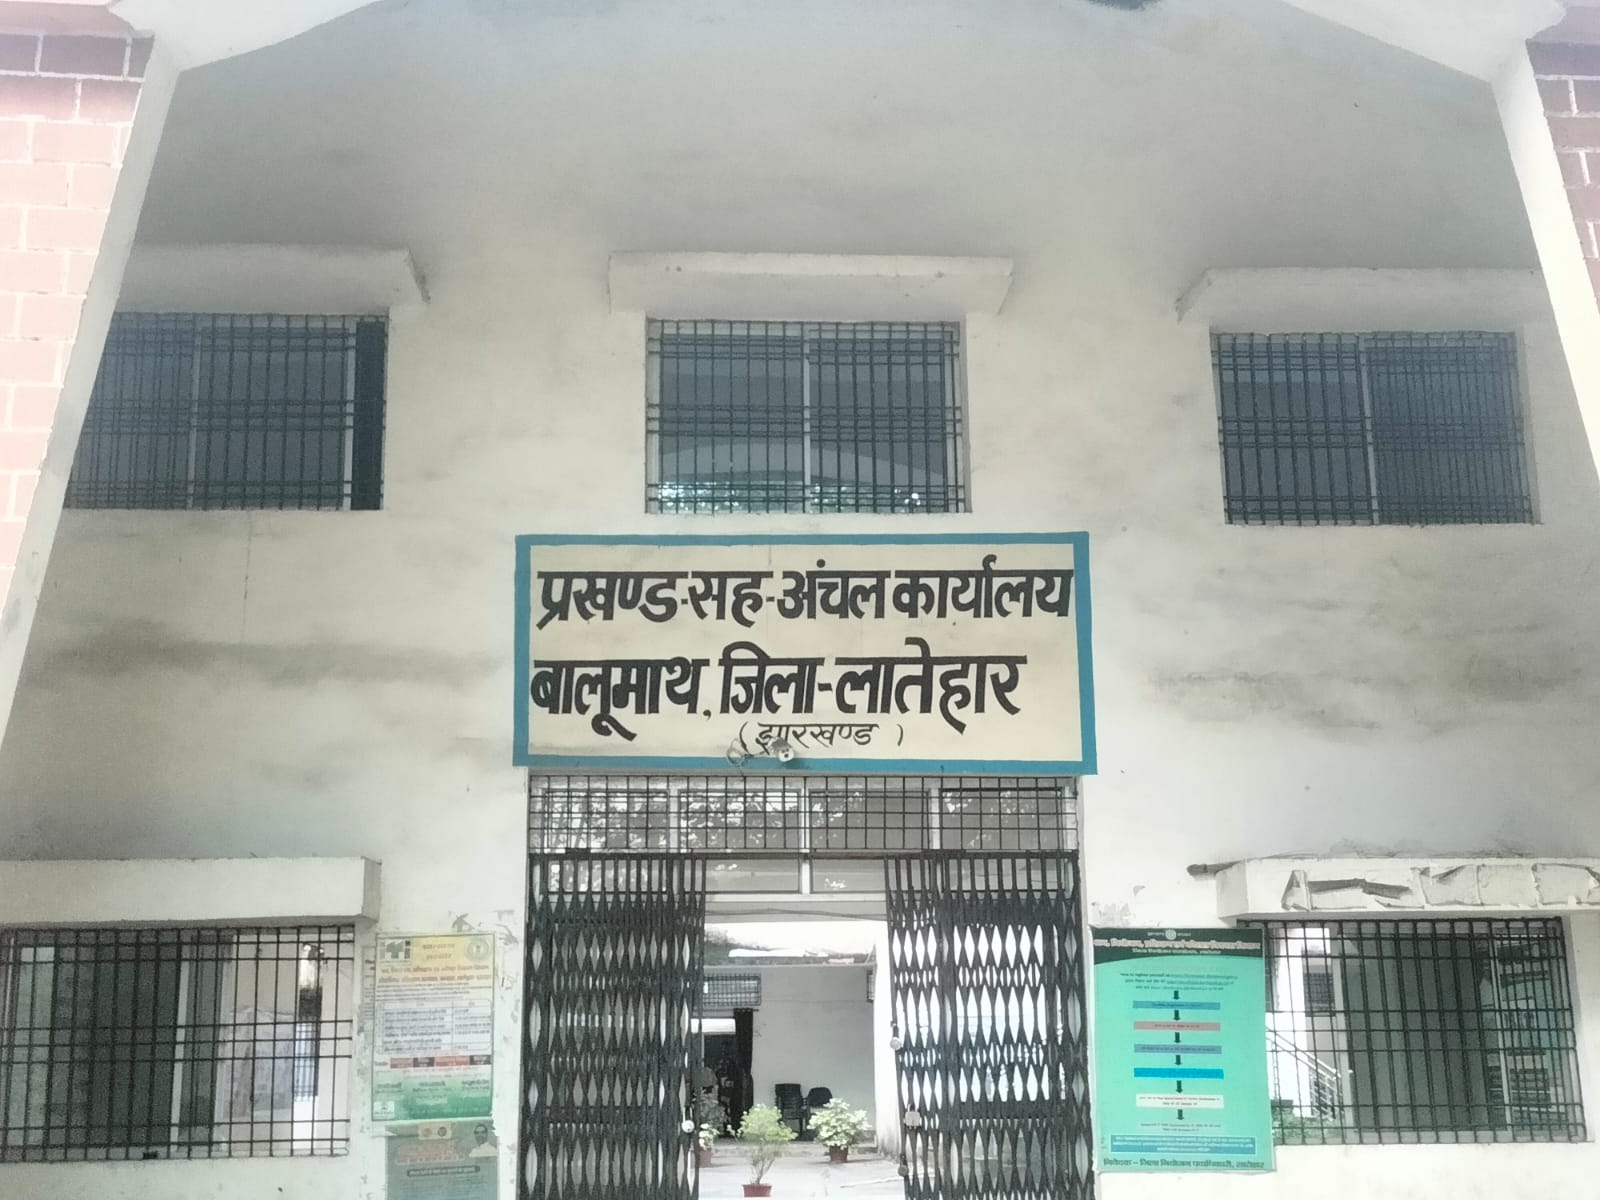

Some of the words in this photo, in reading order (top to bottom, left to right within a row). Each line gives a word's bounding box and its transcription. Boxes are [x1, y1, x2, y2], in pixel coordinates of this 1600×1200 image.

[893, 554, 1074, 619] कार्यालय
[530, 655, 711, 742] बालूमाथ,
[718, 637, 1028, 733] जिला-लातेहार
